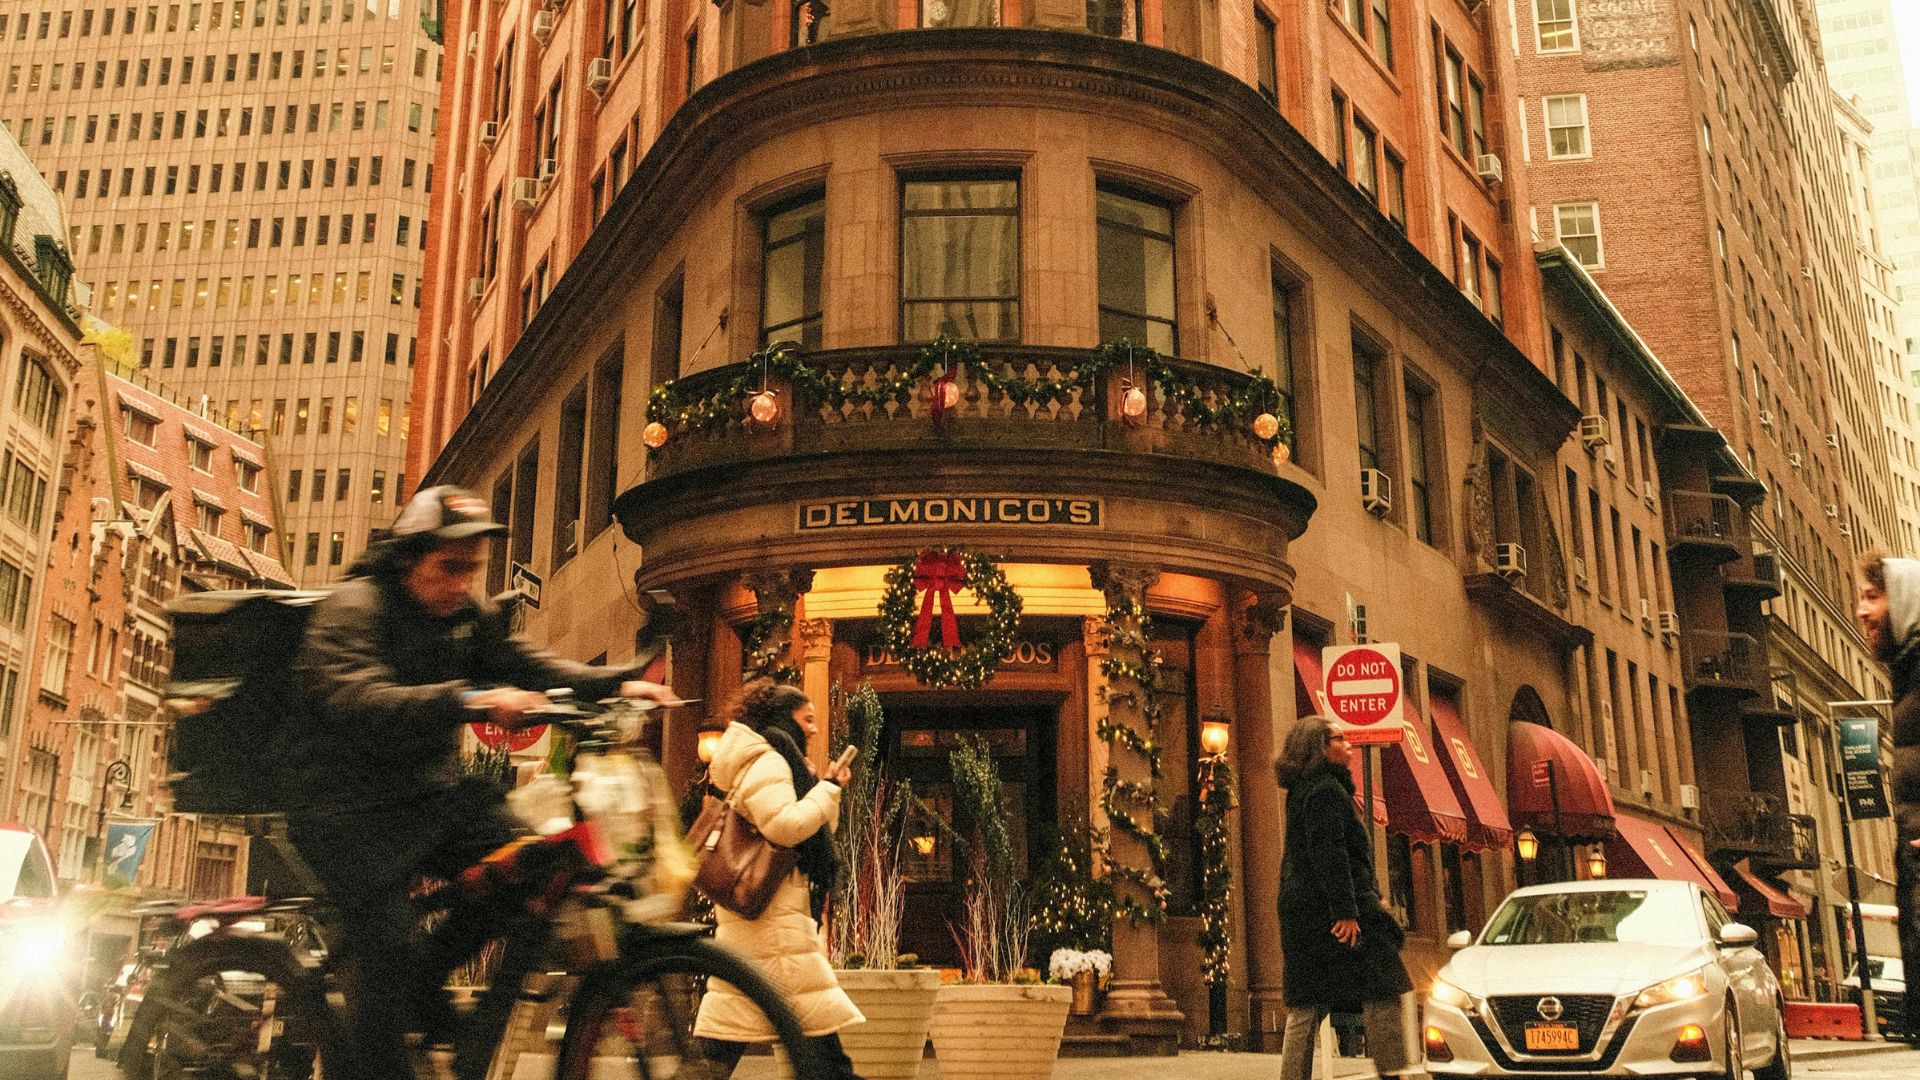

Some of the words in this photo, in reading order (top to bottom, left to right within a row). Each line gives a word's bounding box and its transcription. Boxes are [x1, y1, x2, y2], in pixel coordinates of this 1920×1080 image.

[806, 499, 1092, 527] DELMONICO'S
[1337, 664, 1355, 677] DO
[1361, 661, 1387, 676] NOT
[1340, 697, 1387, 713] ENTER
